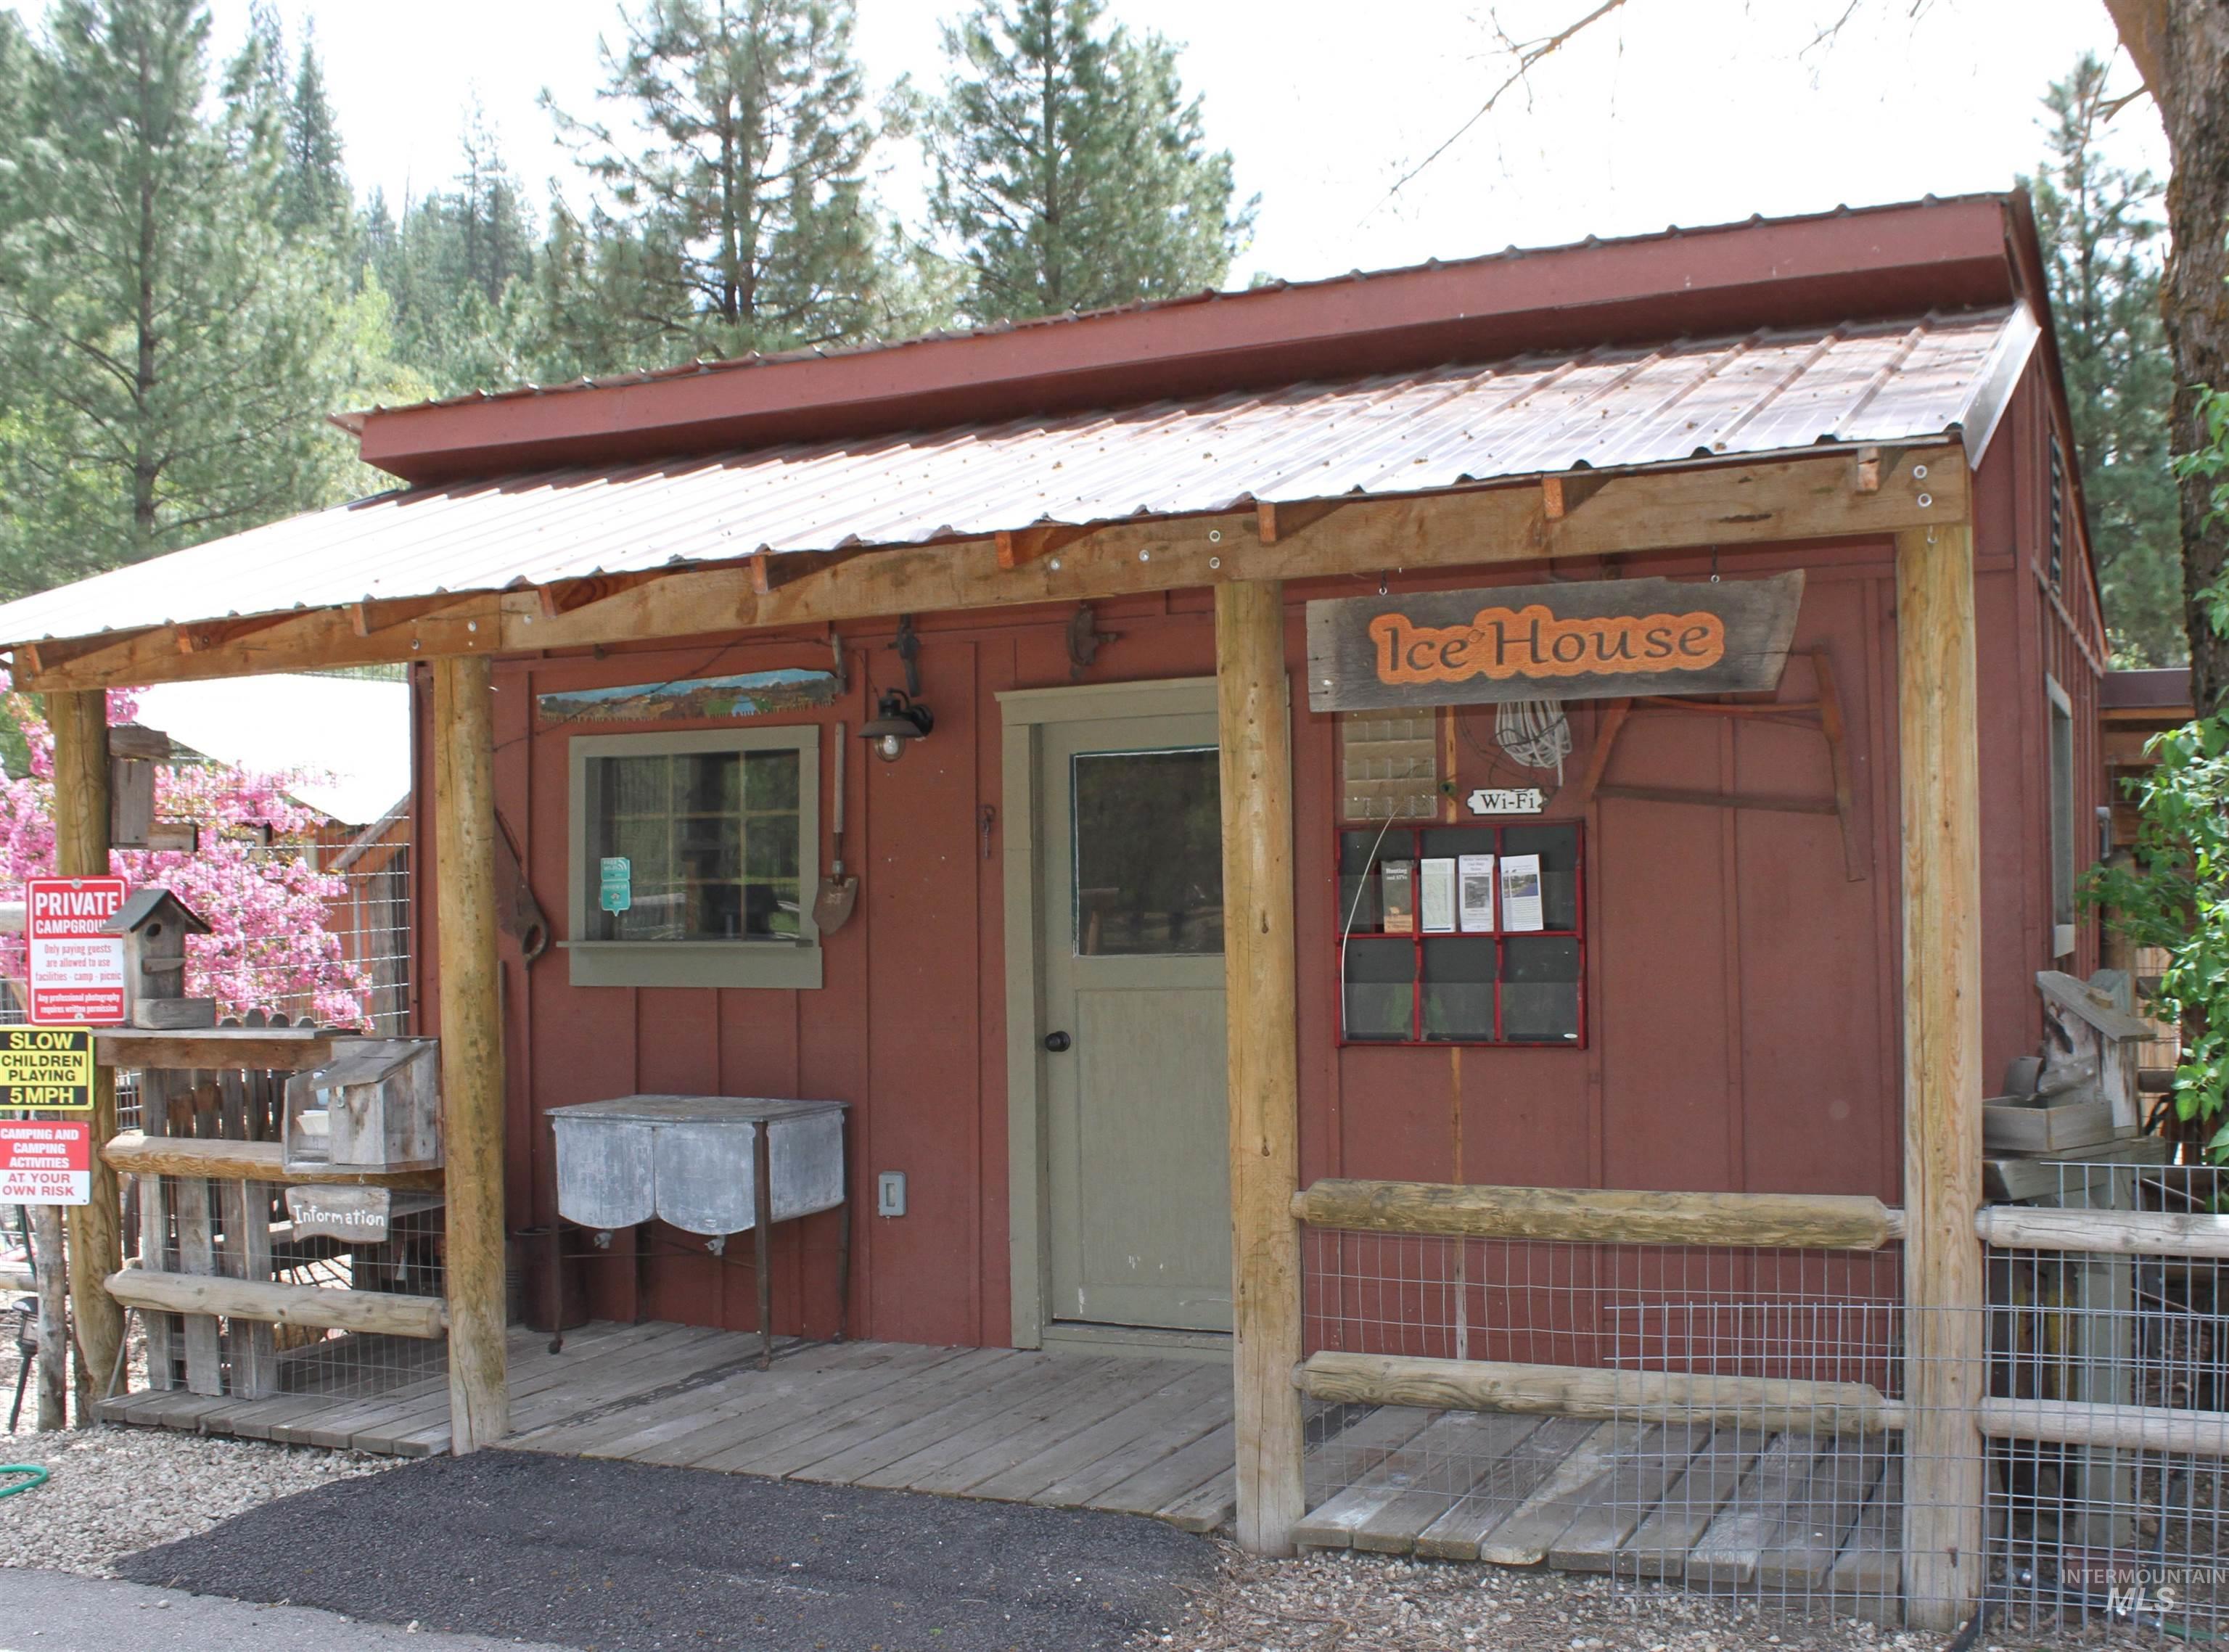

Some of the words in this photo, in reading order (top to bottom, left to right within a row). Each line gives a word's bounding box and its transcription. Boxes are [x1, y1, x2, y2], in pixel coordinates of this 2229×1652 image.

[1384, 626, 1468, 671] Ice
[1488, 619, 1711, 666] House
[1480, 793, 1535, 809] Wi-Fi
[35, 892, 118, 916] PRIVATE
[36, 919, 107, 934] CAMPGROU
[44, 944, 59, 956] Only
[62, 944, 85, 956] paying
[87, 945, 112, 956] guests
[59, 958, 86, 967] allowed
[89, 958, 96, 967] to
[36, 971, 67, 981] facilities
[74, 973, 93, 982] camp
[100, 971, 122, 982] picnic
[49, 993, 84, 1003] professional
[85, 993, 120, 1003] photography
[65, 1004, 86, 1013] written
[86, 1004, 118, 1014] permission
[9, 1032, 73, 1050] SLOW
[1, 1055, 83, 1067] CHILDREN
[8, 1069, 75, 1081] PLAYING
[9, 1087, 22, 1104] 5
[25, 1087, 74, 1104] MPH
[0, 1128, 53, 1140] CAMPING
[54, 1129, 79, 1141] AND
[13, 1143, 66, 1154] CAMPING
[9, 1156, 70, 1168] ACTIVITIES
[8, 1173, 25, 1183] AT
[30, 1173, 70, 1183] YOUR
[2, 1185, 36, 1196] OWN
[41, 1186, 75, 1196] RISK
[292, 1204, 385, 1227] Information
